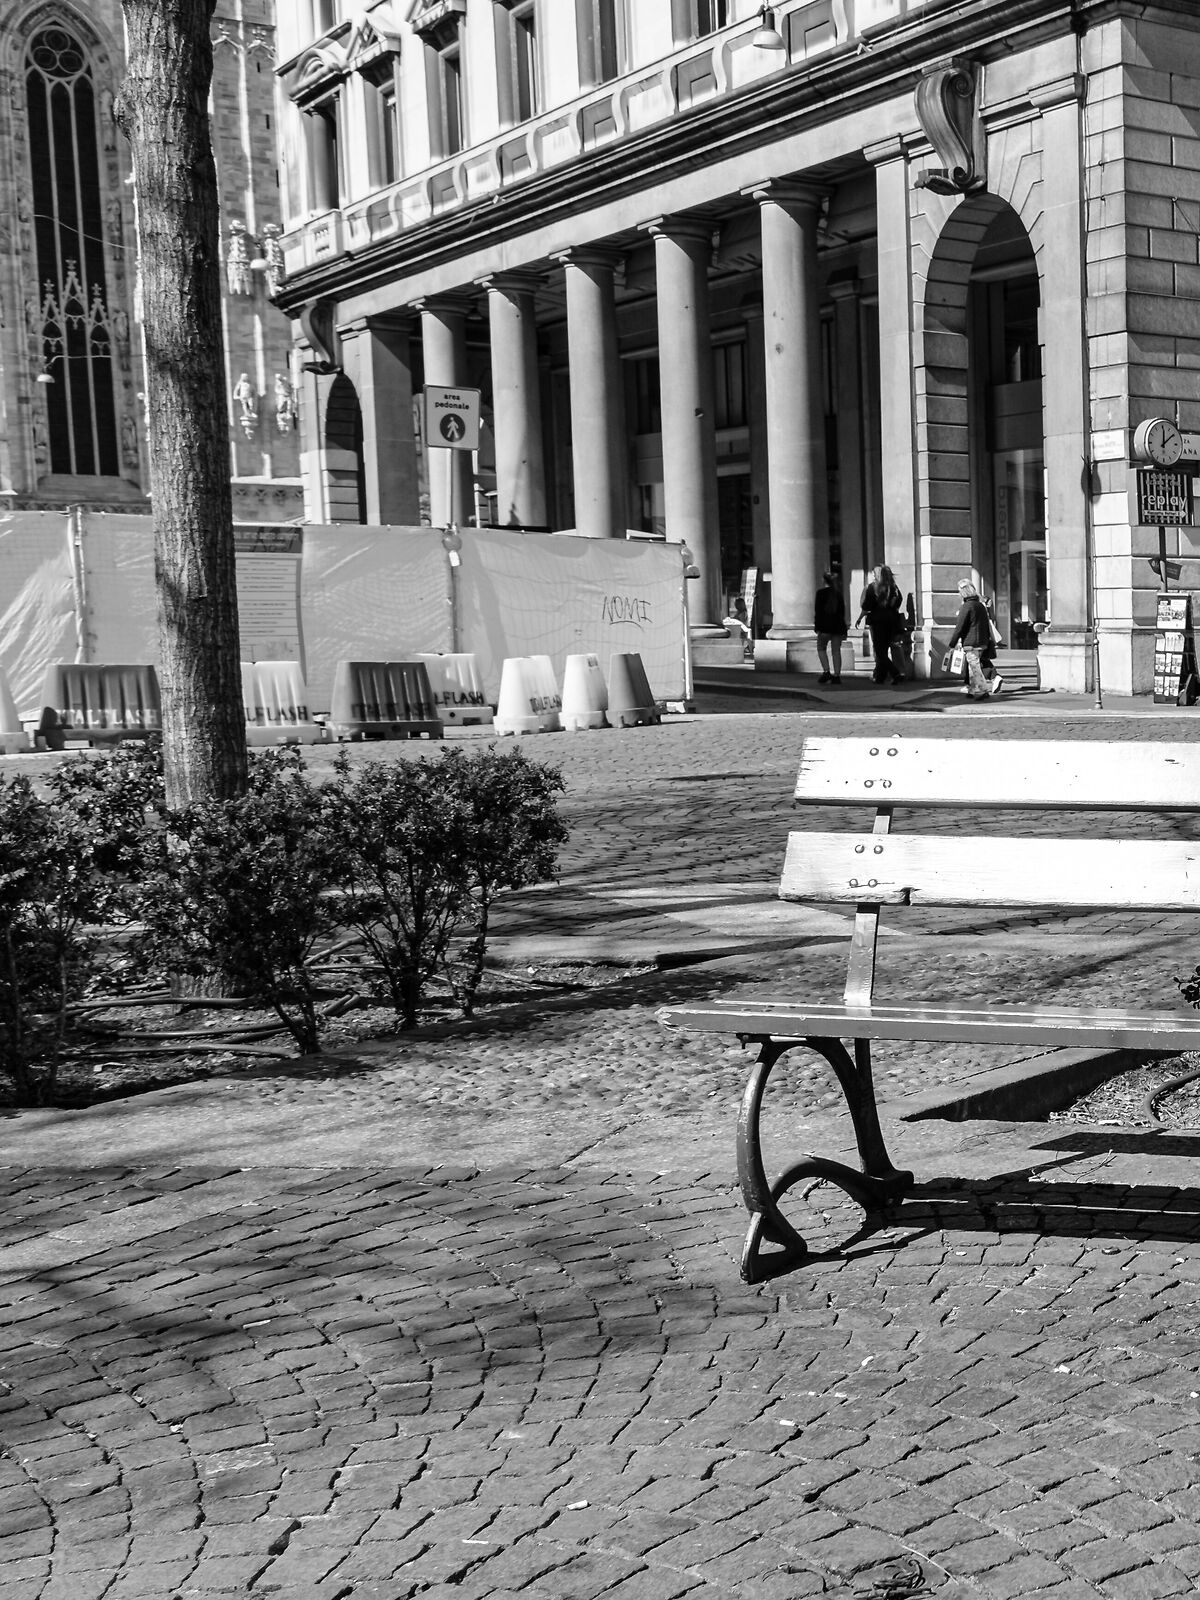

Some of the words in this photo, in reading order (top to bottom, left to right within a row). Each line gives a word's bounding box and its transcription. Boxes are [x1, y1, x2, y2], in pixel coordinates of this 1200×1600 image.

[435, 402, 469, 410] pedonale
[1183, 448, 1198, 456] ANA
[1142, 493, 1187, 510] replay
[434, 691, 484, 705] LFLASH
[246, 706, 308, 721] LFLASH
